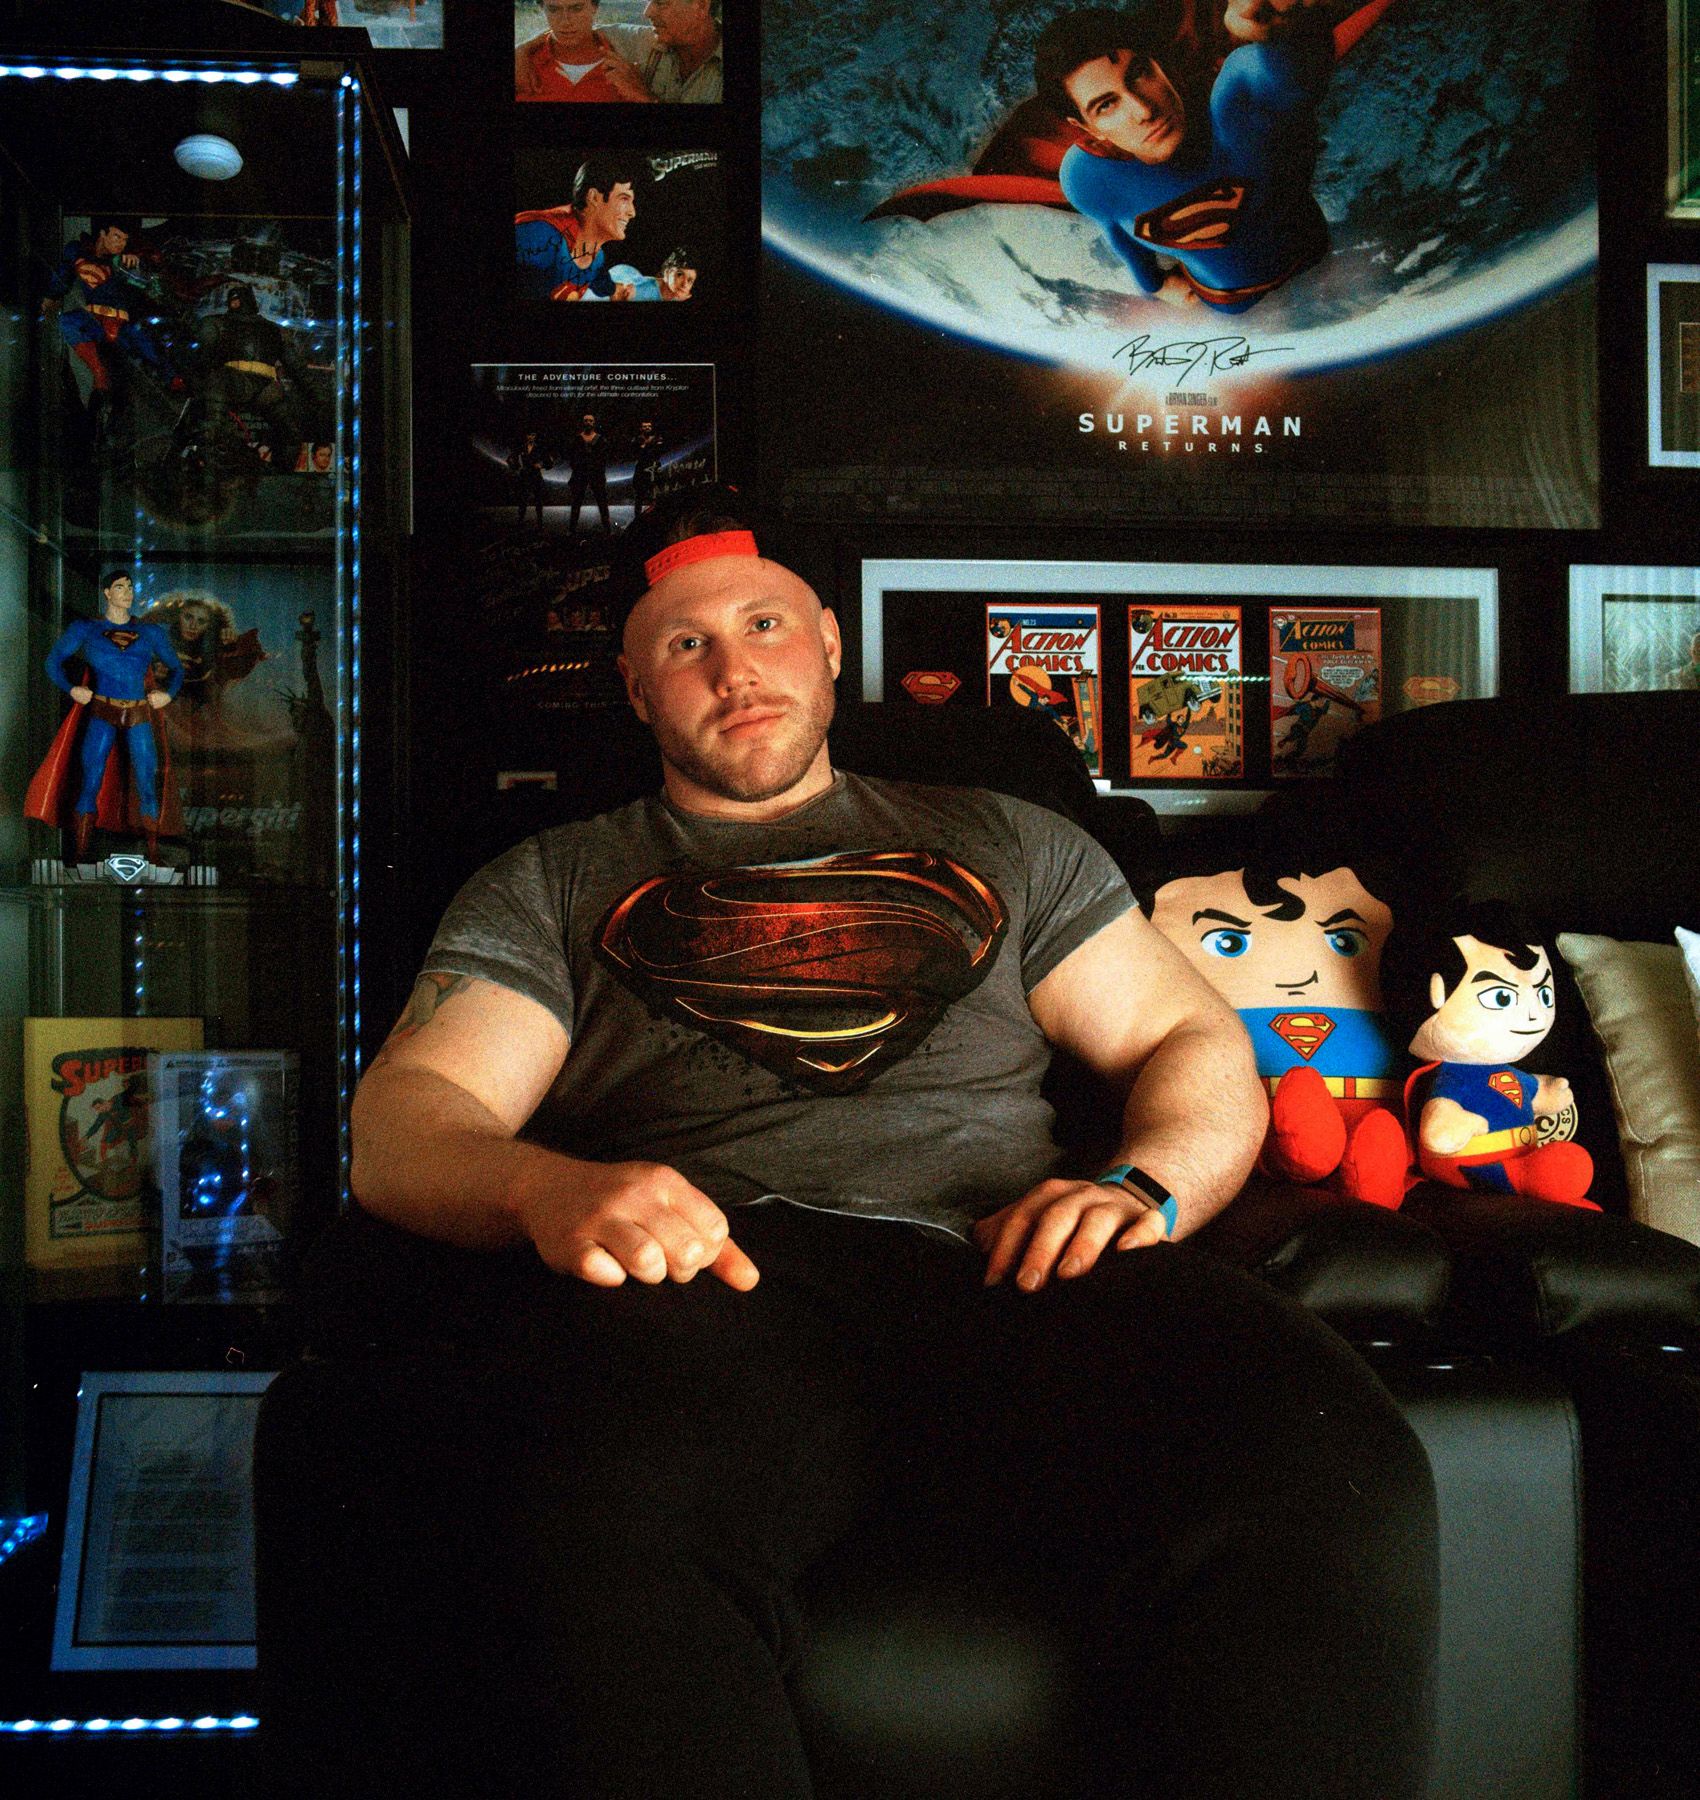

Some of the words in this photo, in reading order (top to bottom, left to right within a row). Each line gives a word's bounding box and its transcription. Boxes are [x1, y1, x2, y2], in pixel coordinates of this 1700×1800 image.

[518, 373, 538, 382] THE
[542, 373, 602, 382] ADVENTURE
[1078, 412, 1302, 437] SUPERMAN
[1118, 440, 1264, 454] RETURNS
[990, 620, 1097, 670] ACTION
[1131, 613, 1240, 669] ACTION
[1302, 640, 1346, 651] COMICS
[1004, 654, 1084, 673] COMICS
[1146, 652, 1230, 673] COMICS
[182, 800, 301, 837] upergirl
